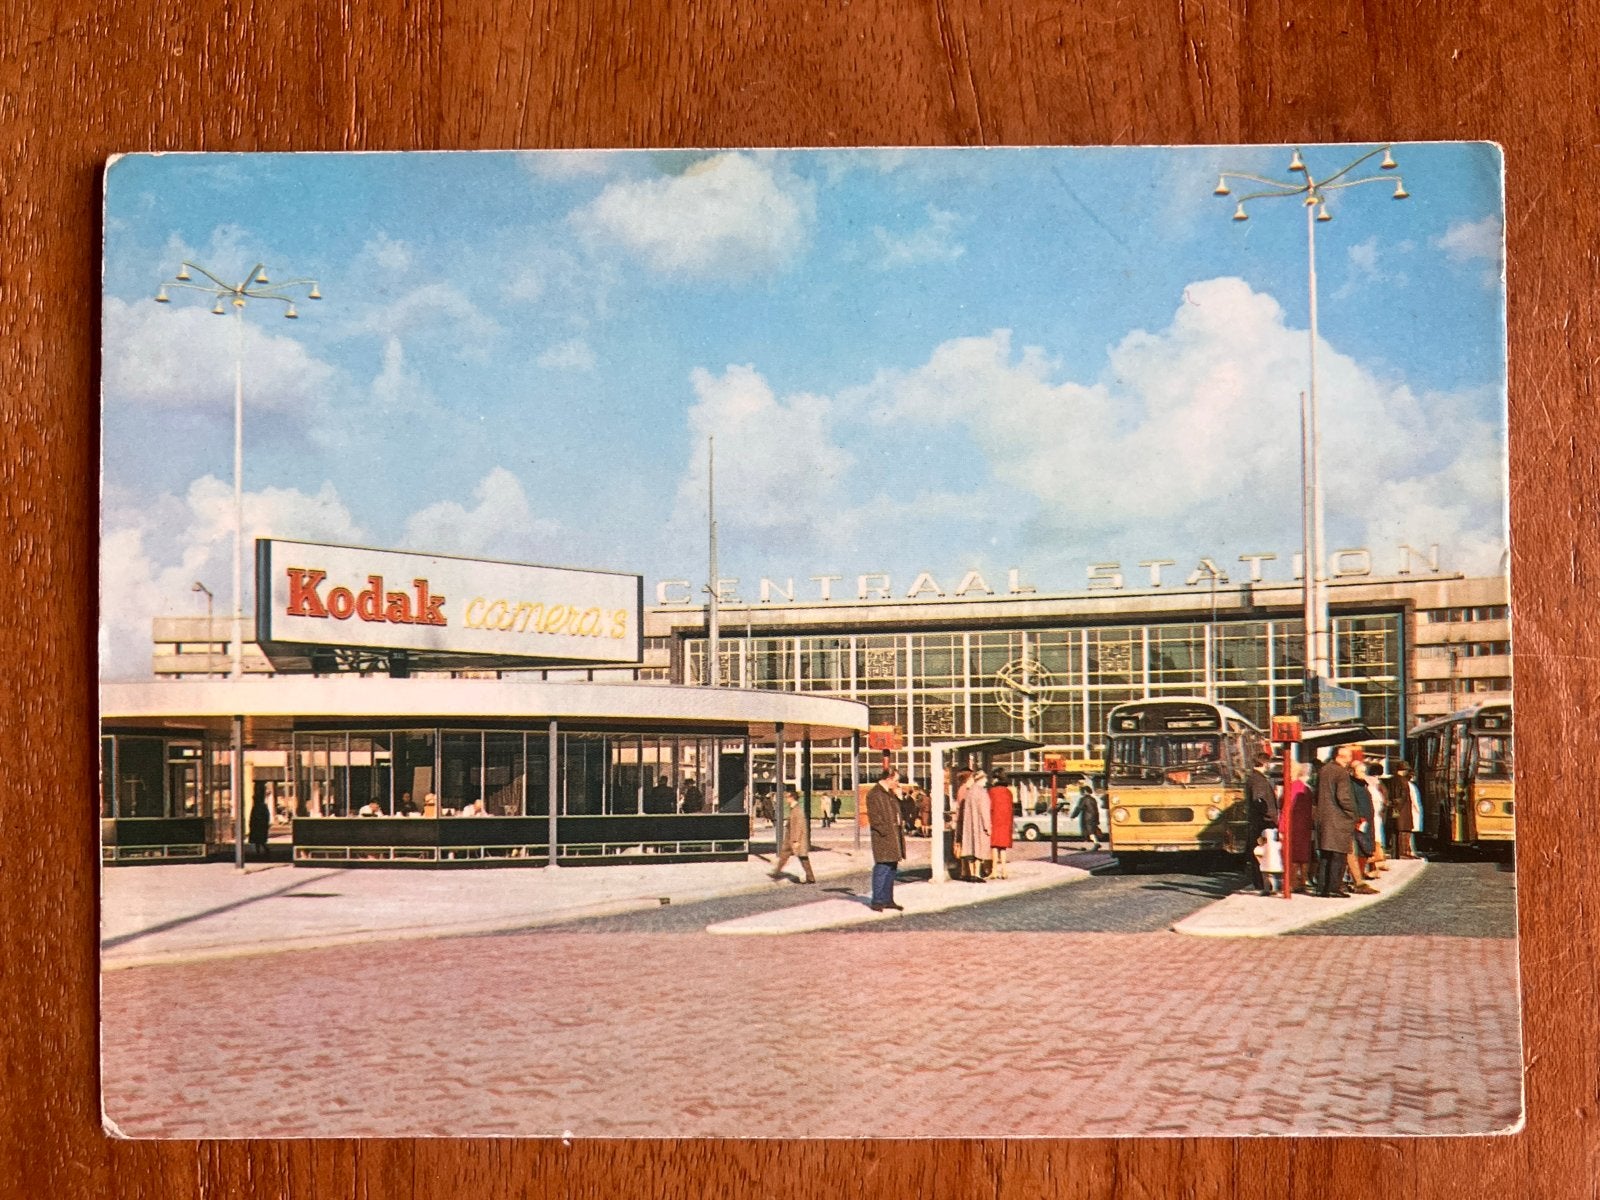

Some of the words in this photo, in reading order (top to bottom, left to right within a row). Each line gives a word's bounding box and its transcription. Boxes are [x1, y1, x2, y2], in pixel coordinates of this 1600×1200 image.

[286, 568, 447, 626] Kodak
[464, 595, 628, 638] camera's
[656, 569, 1036, 604] CENTRAAL
[1087, 544, 1440, 590] STATION
